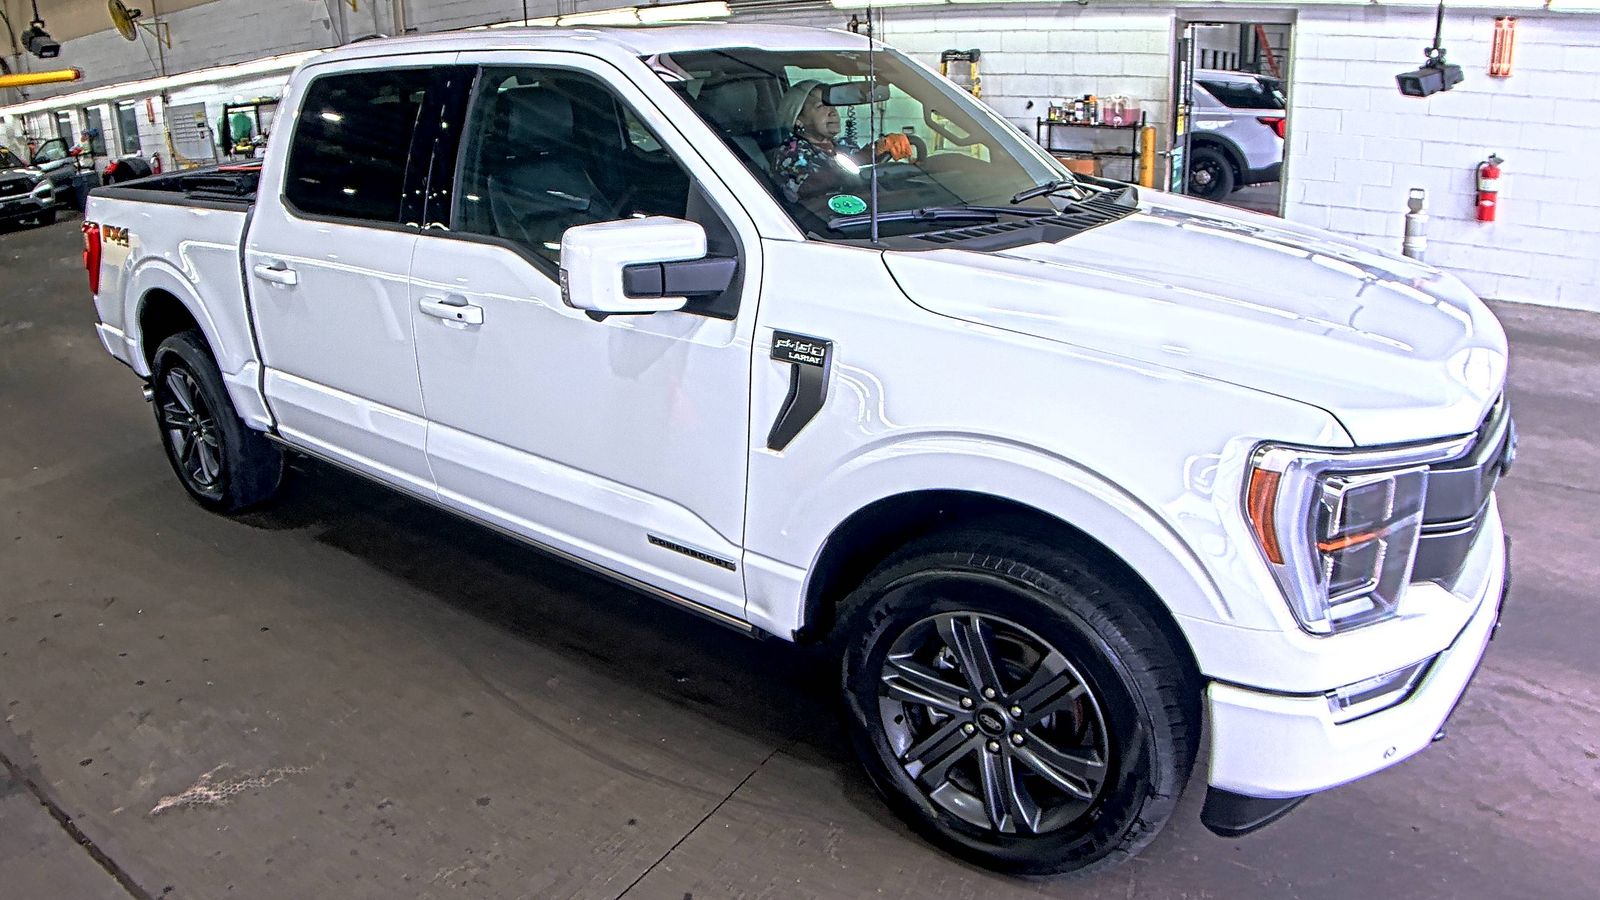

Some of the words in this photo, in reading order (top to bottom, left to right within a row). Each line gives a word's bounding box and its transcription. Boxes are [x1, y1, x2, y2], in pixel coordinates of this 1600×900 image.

[102, 224, 129, 243] FX4
[775, 338, 824, 357] F-150
[788, 352, 821, 364] LARIAT
